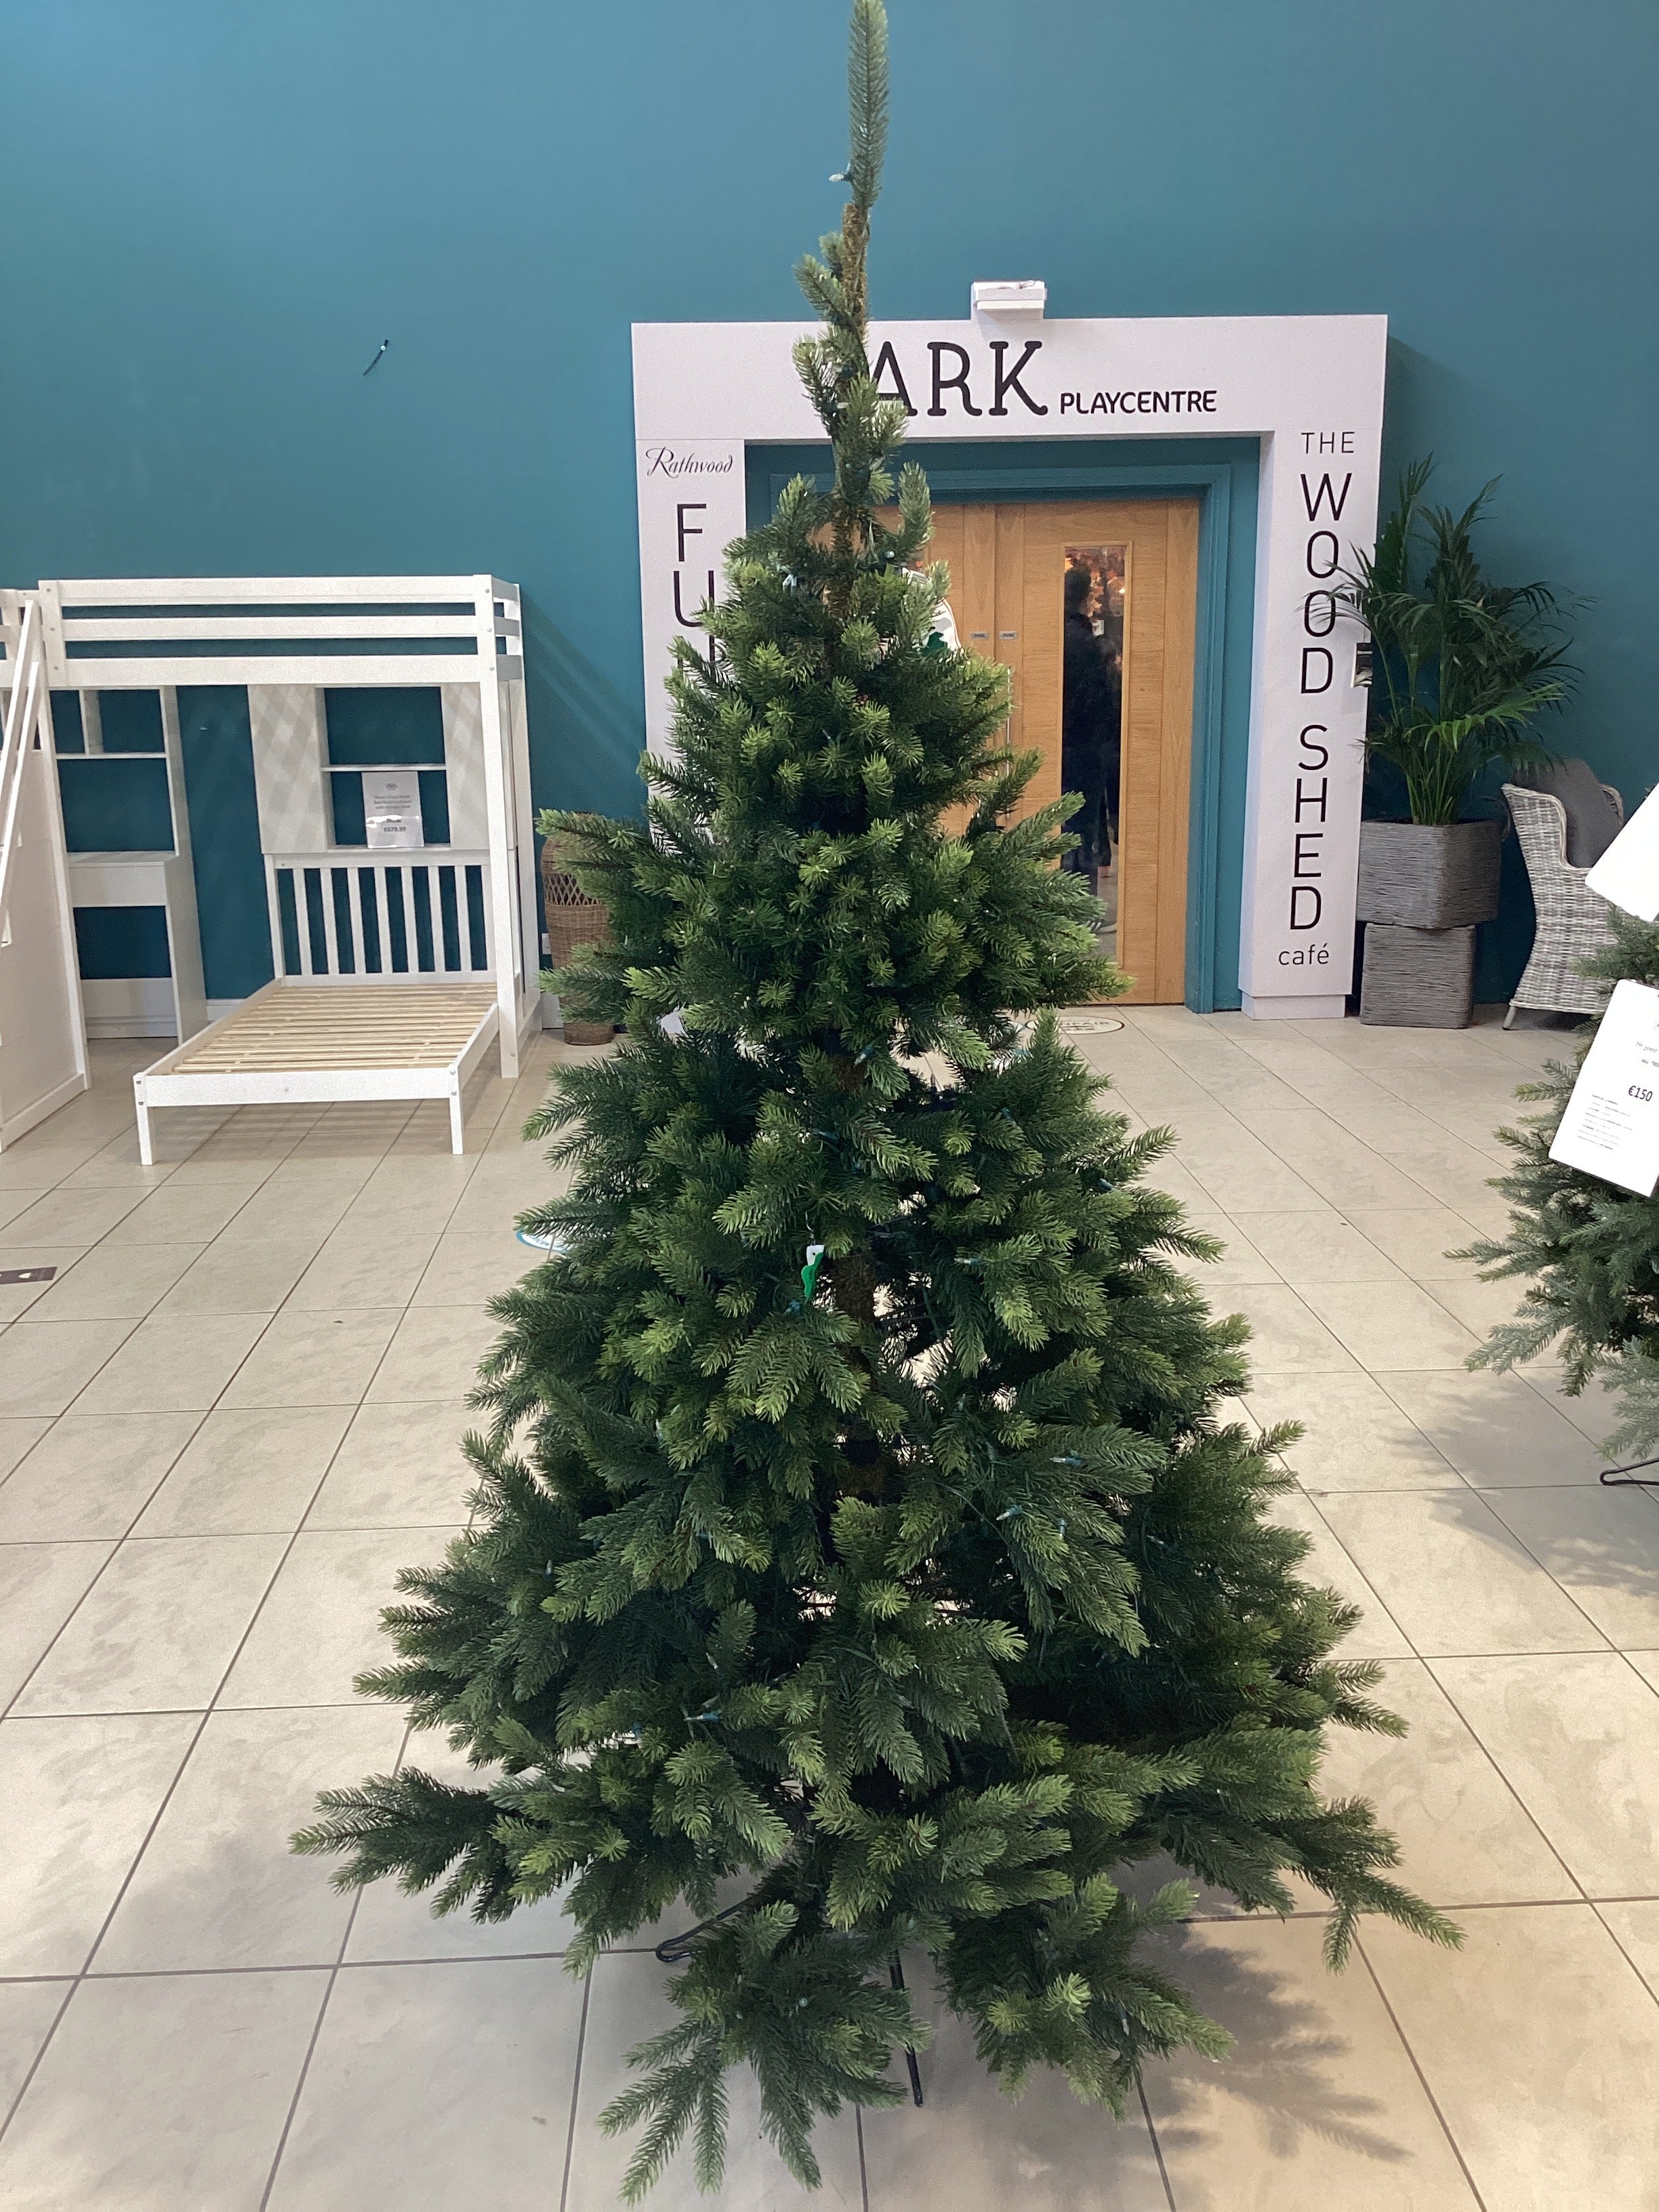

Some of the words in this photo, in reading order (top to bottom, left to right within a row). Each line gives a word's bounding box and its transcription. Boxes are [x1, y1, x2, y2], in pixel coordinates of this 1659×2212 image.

[800, 340, 1048, 417] ARK
[1060, 390, 1217, 415] PLAYCENTRE
[1300, 432, 1355, 454] THE
[645, 447, 733, 478] Rathwood
[1300, 472, 1352, 695] WOOD
[1290, 724, 1329, 930] SHED
[1278, 943, 1330, 966] café
[1628, 1085, 1653, 1102] €150
